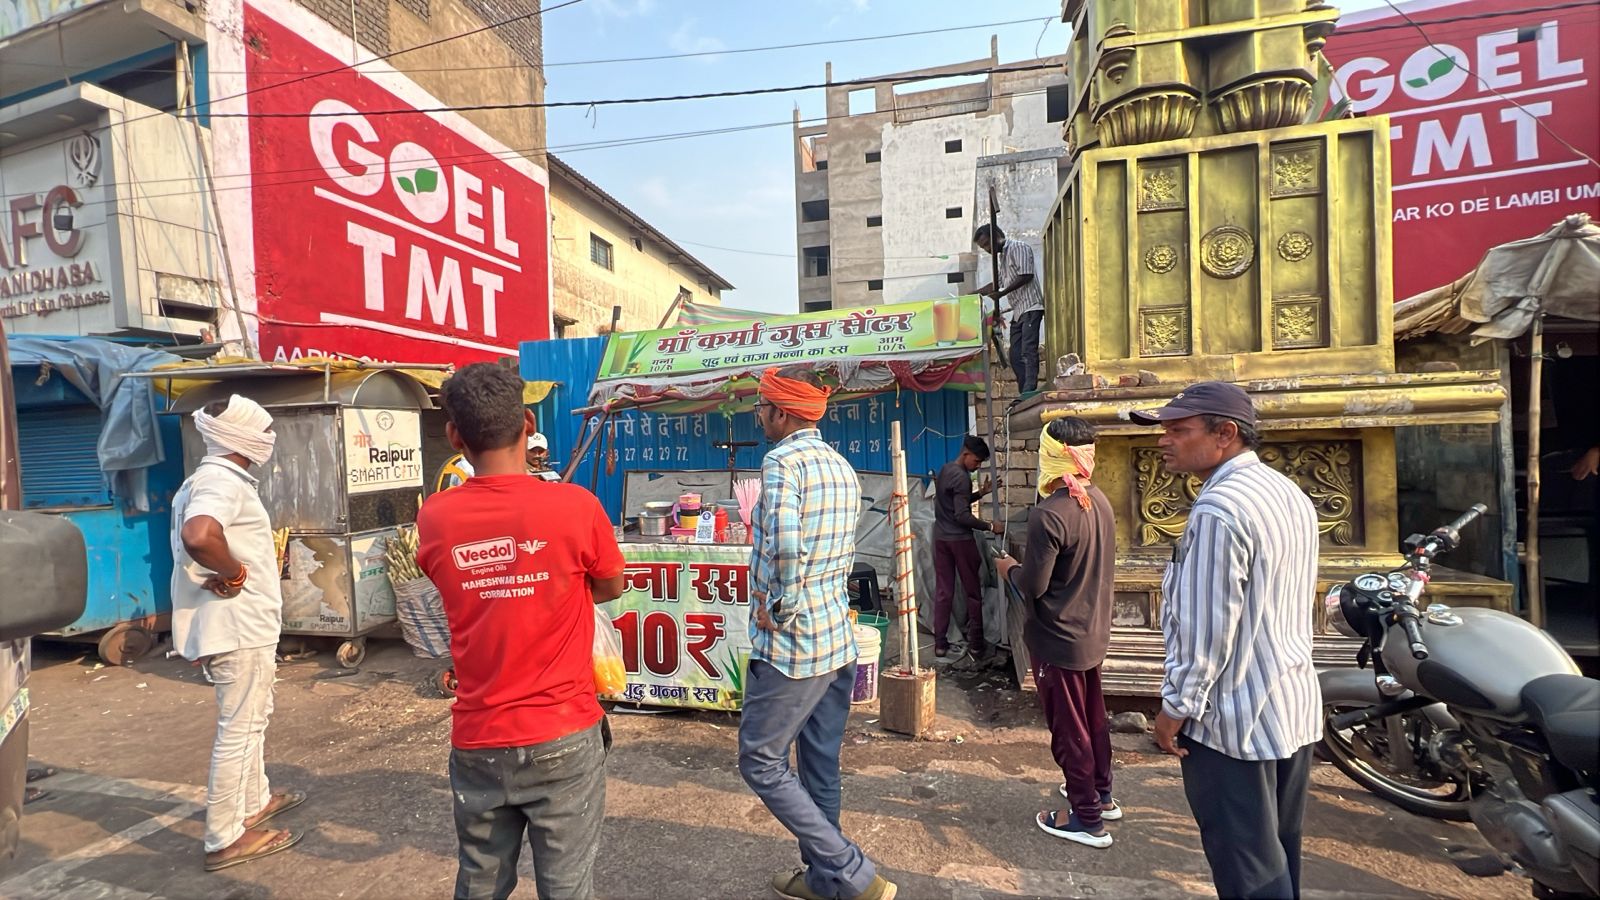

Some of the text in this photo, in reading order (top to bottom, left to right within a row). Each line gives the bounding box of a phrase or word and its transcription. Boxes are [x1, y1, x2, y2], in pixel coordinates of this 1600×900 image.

[1330, 20, 1584, 112] GOEL
[1390, 101, 1552, 176] MT
[309, 98, 519, 259] GOEL
[1426, 202, 1454, 218] KO
[1461, 198, 1490, 214] DE
[1496, 189, 1560, 210] LAMBI
[347, 220, 504, 338] TMT
[656, 329, 697, 355] माँ
[697, 321, 766, 351] कर्मा
[839, 308, 916, 337] सेंटर
[880, 336, 904, 344] आम
[724, 353, 740, 364] एवं
[742, 352, 770, 363] ताजा
[773, 349, 803, 360] गन्ना
[808, 346, 824, 356] का
[829, 344, 849, 354] रस
[641, 412, 653, 436] से
[657, 412, 688, 438] देना
[369, 445, 415, 467] Raipur
[624, 448, 636, 461] 27
[643, 447, 654, 461] 42
[659, 446, 671, 461] 29
[849, 439, 861, 454] 42
[869, 439, 880, 453] 29
[350, 464, 421, 483] SMART CITY
[458, 542, 512, 563] Veedol
[471, 563, 507, 576] Engine Oils
[516, 571, 550, 584] SALES
[689, 562, 750, 605] रस
[650, 684, 690, 700] गन्ना
[692, 686, 720, 703] रस
